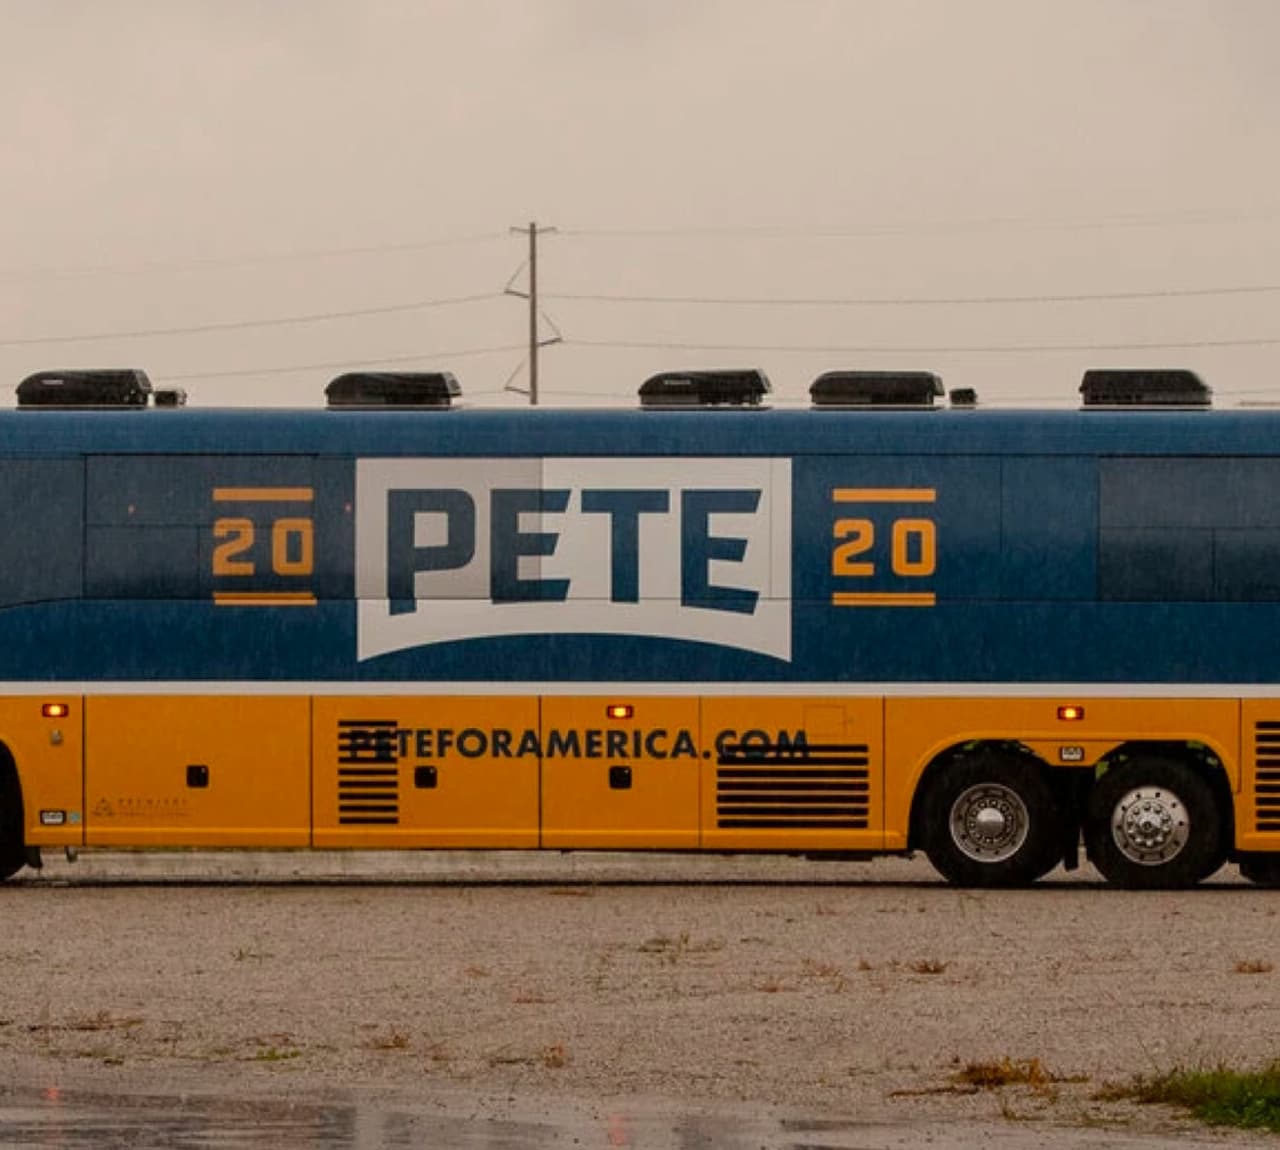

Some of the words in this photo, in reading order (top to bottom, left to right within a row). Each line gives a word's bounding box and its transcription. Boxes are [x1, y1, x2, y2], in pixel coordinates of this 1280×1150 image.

[212, 517, 314, 576] 20
[387, 488, 762, 616] PETE
[831, 518, 936, 576] 20
